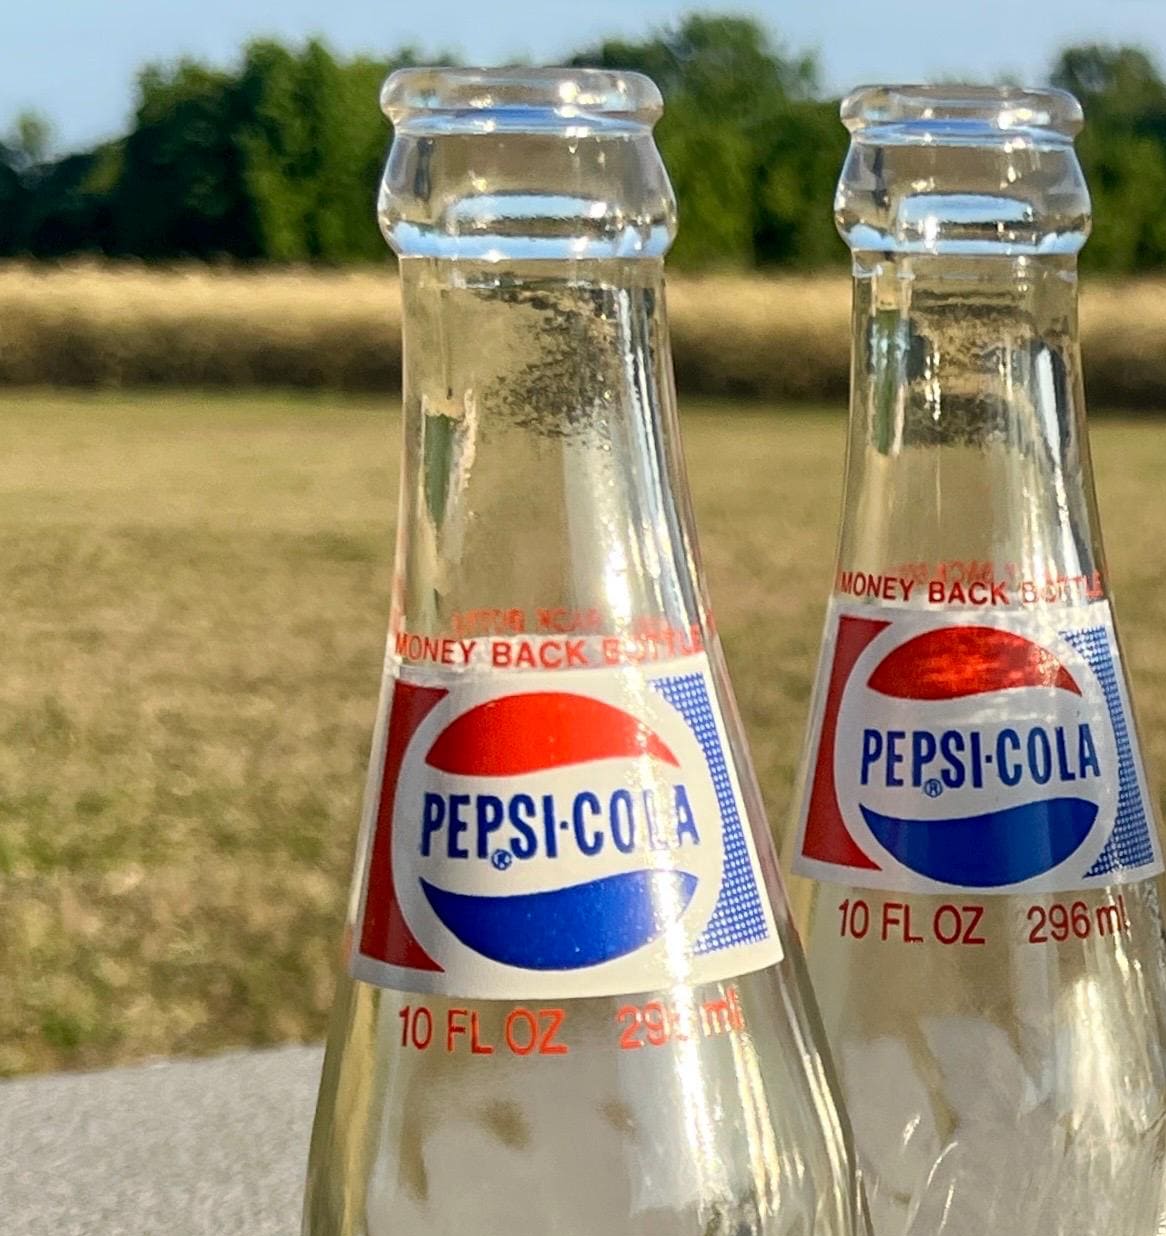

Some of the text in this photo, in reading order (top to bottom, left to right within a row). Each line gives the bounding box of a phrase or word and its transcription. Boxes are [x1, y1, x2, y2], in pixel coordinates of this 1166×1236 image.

[841, 572, 914, 602] MONEY
[928, 580, 1008, 606] BACK
[395, 633, 475, 664] MONEY
[492, 639, 587, 667] BACK
[838, 899, 869, 939] 10
[882, 903, 923, 944] FL
[933, 904, 985, 945] OZ
[1027, 901, 1090, 944] 296
[399, 1005, 433, 1050] 10
[448, 1009, 493, 1055] FL
[505, 1008, 568, 1056] OZ
[616, 1000, 688, 1050] 29
